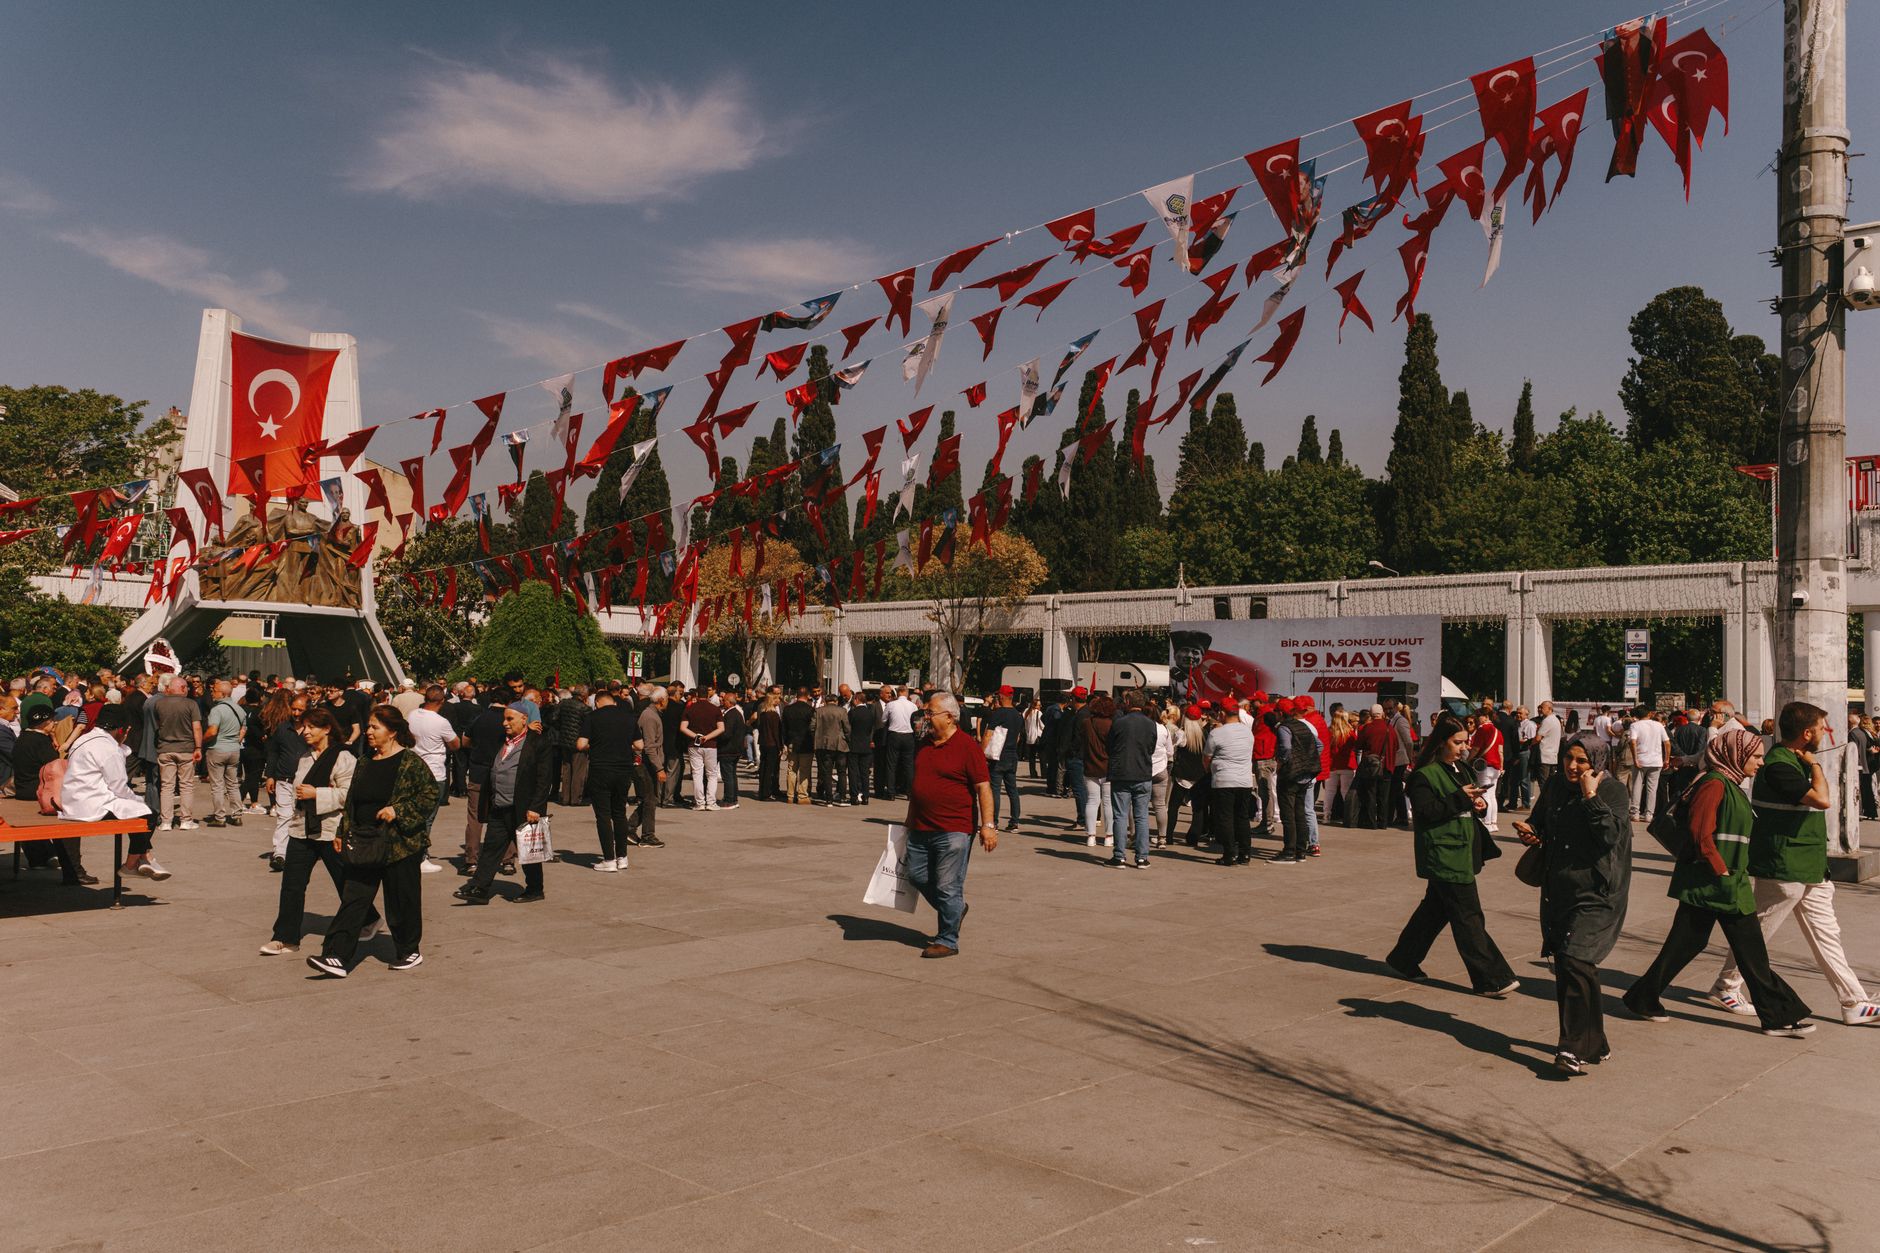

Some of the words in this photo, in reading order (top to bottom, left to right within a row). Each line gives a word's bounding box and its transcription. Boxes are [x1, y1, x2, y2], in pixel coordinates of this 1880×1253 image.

[1280, 638, 1299, 648] BİR
[1301, 639, 1335, 648] ADIM,
[1337, 638, 1386, 647] SONSUZ
[1389, 637, 1425, 646] UMUT
[1292, 651, 1318, 668] 19
[1325, 651, 1412, 668] MAYIS
